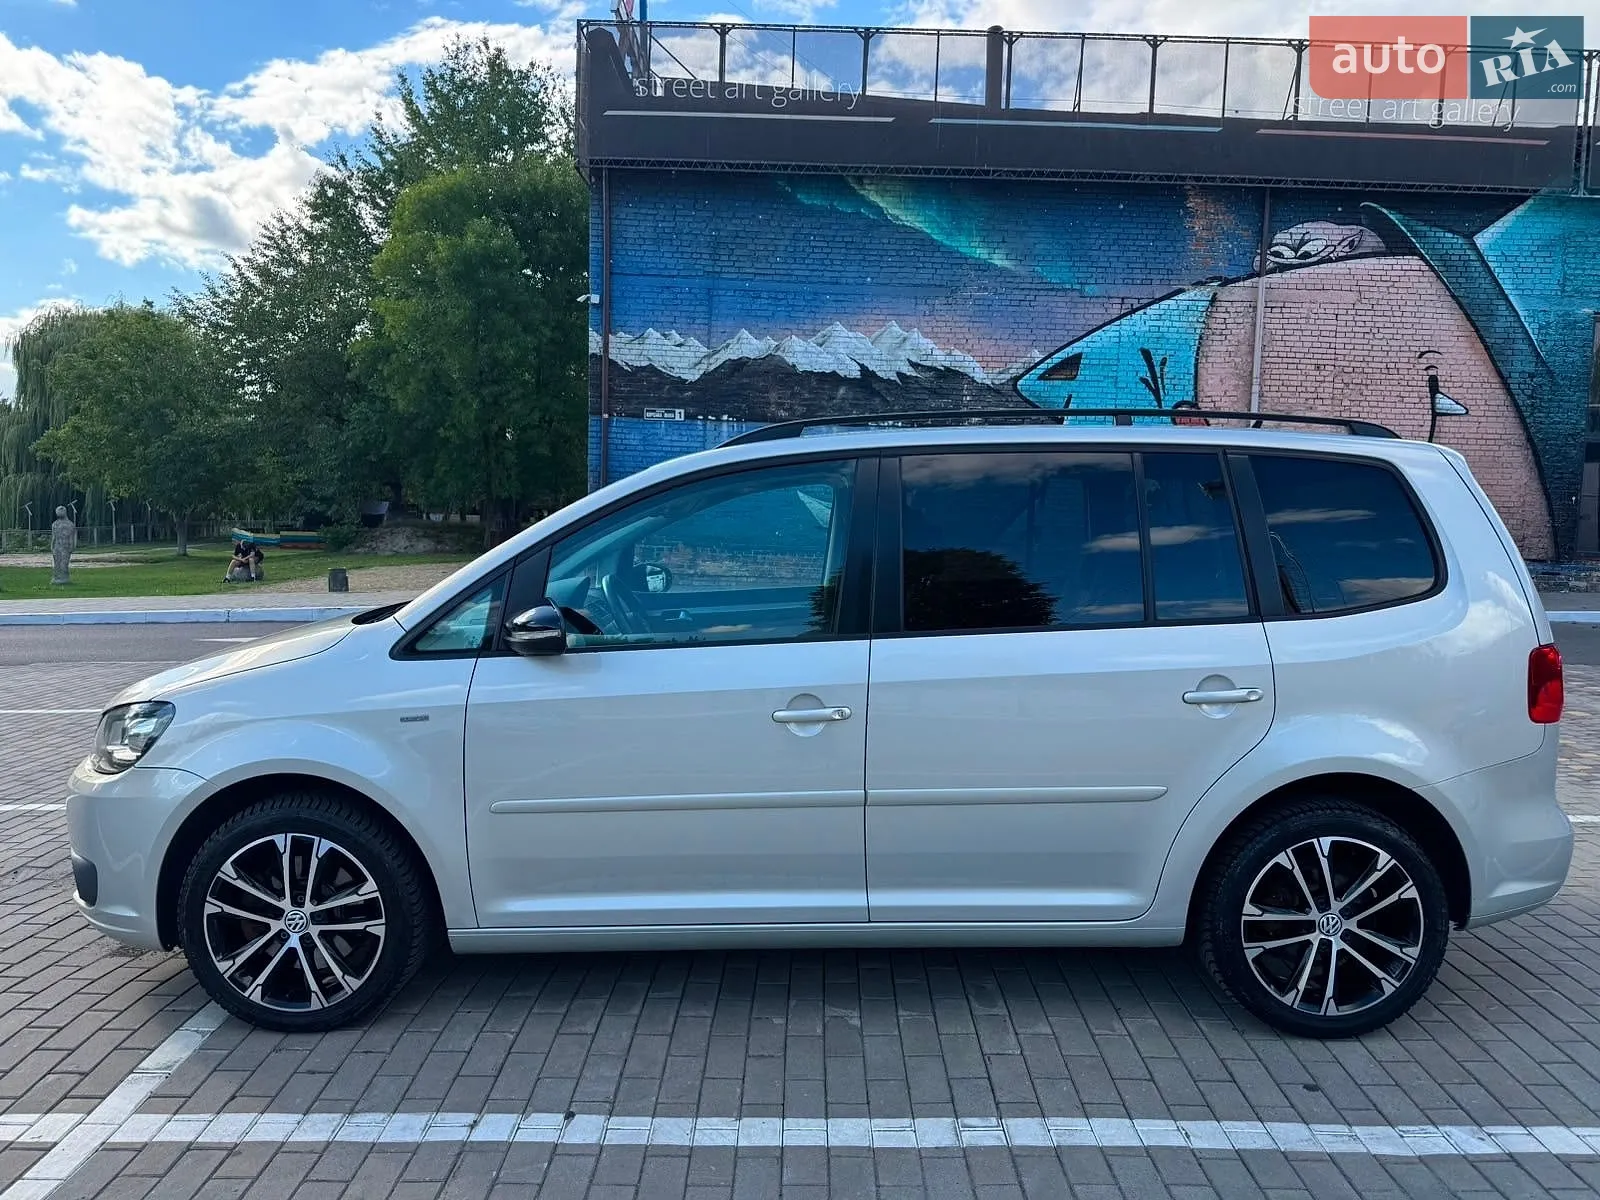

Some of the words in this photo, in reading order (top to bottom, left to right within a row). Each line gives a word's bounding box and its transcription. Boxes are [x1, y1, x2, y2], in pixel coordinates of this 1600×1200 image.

[635, 76, 716, 98] street
[724, 77, 763, 99] art
[771, 75, 862, 110] gallery
[1293, 94, 1373, 119] street
[1382, 97, 1424, 120] art
[1428, 96, 1521, 132] gallery
